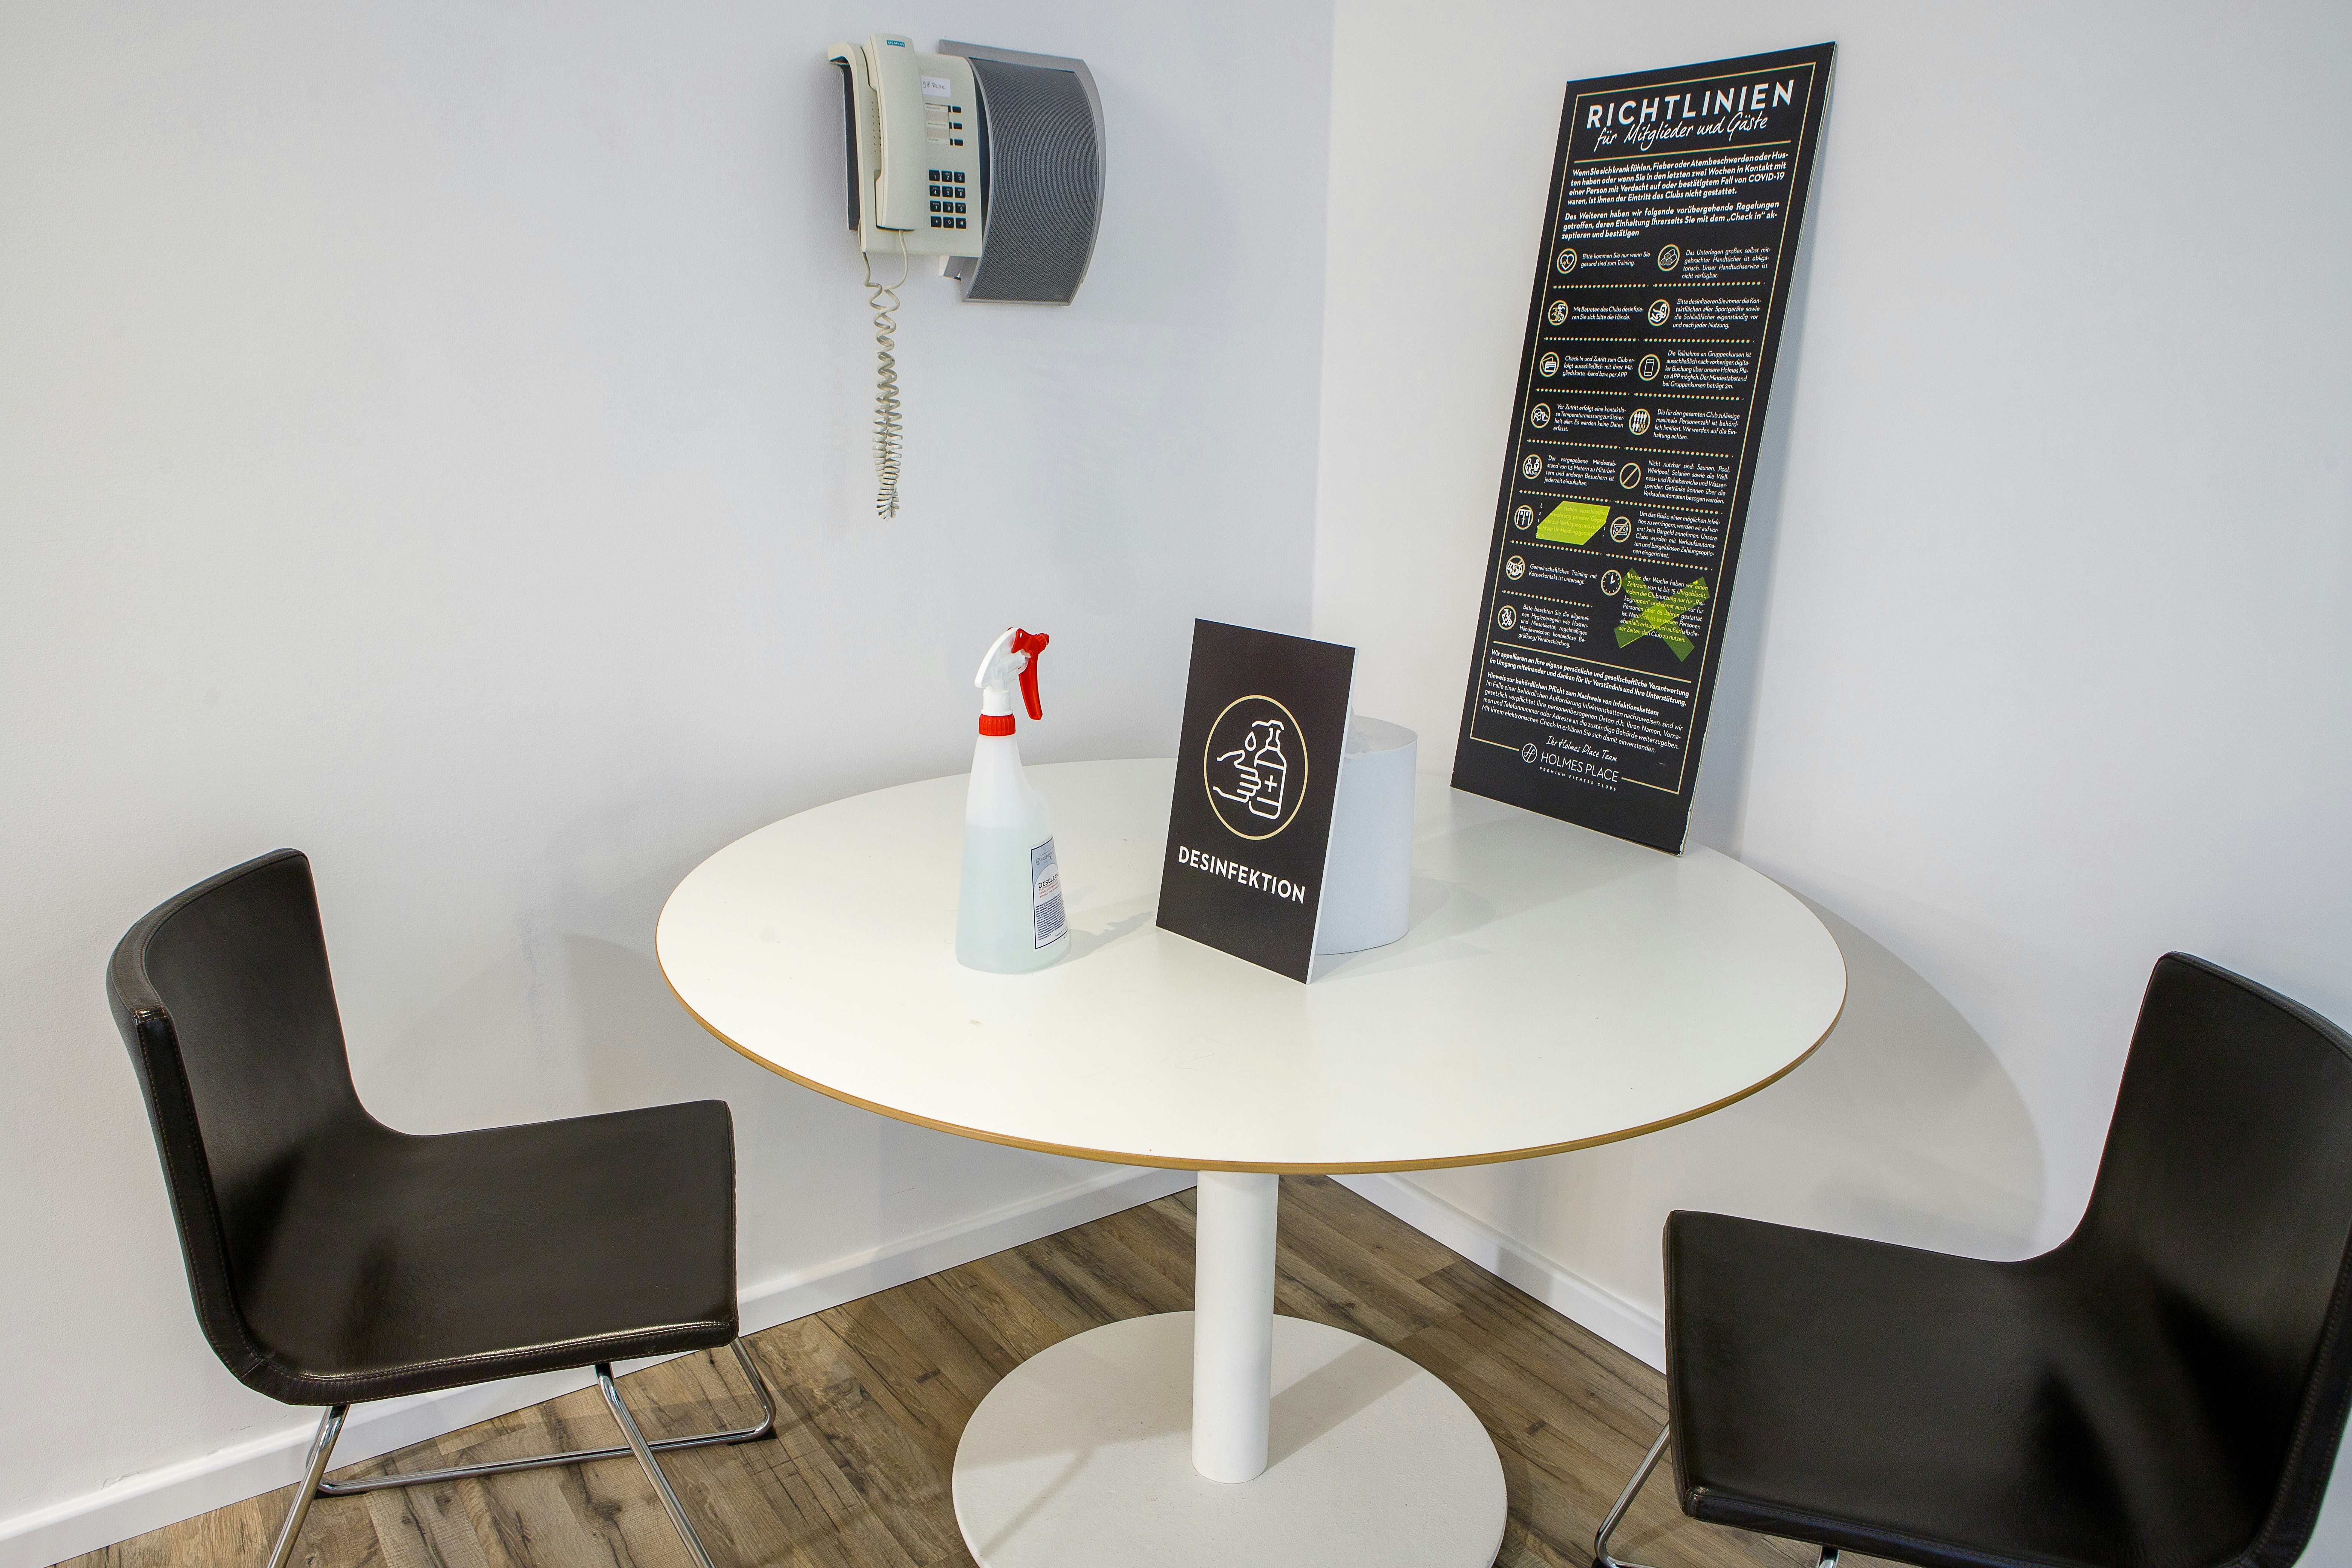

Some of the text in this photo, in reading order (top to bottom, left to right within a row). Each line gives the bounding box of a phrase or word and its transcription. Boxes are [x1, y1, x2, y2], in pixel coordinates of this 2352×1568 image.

[1586, 79, 1794, 129] RICHTLINIEN
[1593, 110, 1768, 152] für Mitglieder und Gäste
[1612, 165, 1630, 174] krank
[1630, 164, 1652, 172] fühlen,
[1652, 162, 1674, 170] Fieber
[1674, 160, 1690, 168] oder
[1690, 154, 1754, 167] Atembeschwerden
[1754, 152, 1772, 161] oder
[1771, 151, 1788, 160] Hus-
[1653, 172, 1666, 180] den
[1667, 171, 1690, 179] letzten
[1691, 168, 1707, 177] zwei
[1708, 166, 1736, 175] Wochen
[1736, 165, 1743, 173] in
[1744, 162, 1773, 173] Kontakt
[1773, 161, 1787, 170] mit
[1608, 185, 1619, 193] mit
[1620, 183, 1649, 192] Verdacht
[1649, 182, 1661, 190] auf
[1661, 181, 1678, 189] oder
[1678, 178, 1720, 188] bestätigtem
[1720, 176, 1733, 185] Fall
[1748, 172, 1785, 183] COVID-19
[1627, 193, 1651, 202] Eintritt
[1665, 190, 1684, 199] Clubs
[1684, 189, 1702, 198] nicht
[1703, 187, 1737, 198] gestattet.
[1684, 257, 1710, 265] gebrachter
[1725, 248, 1742, 256] großer,
[1528, 570, 1558, 580] Körperkontakt
[1530, 564, 1569, 575] Gemeinschaftliches
[1571, 570, 1588, 579] Training
[1496, 658, 1516, 670] Umgang
[1516, 664, 1547, 675] miteinander
[1556, 672, 1575, 681] danken
[1592, 679, 1622, 692] Verständnis
[1634, 688, 1645, 697] Ihre
[1646, 691, 1686, 707] Unterstützung.
[1500, 652, 1527, 662] appellieren
[1545, 661, 1563, 670] eigene
[1563, 666, 1593, 676] persönliche
[1603, 674, 1648, 688] gesellschaftliche
[1649, 681, 1689, 698] Verantwortung
[1487, 671, 1506, 681] Hinweis
[1515, 677, 1548, 691] behördlichen
[1548, 684, 1565, 695] Pflicht
[1577, 691, 1602, 703] Nachweis
[1612, 699, 1659, 716] Infektionsketten:
[1546, 735, 1617, 762] Ihr Holmes Place Team
[1539, 766, 1616, 791] PREMIUM FITNESS CLUBS
[1540, 751, 1619, 782] HOLMES PLACE
[1041, 853, 1050, 862] HOLMES
[1179, 846, 1305, 904] DESINFEKTION
